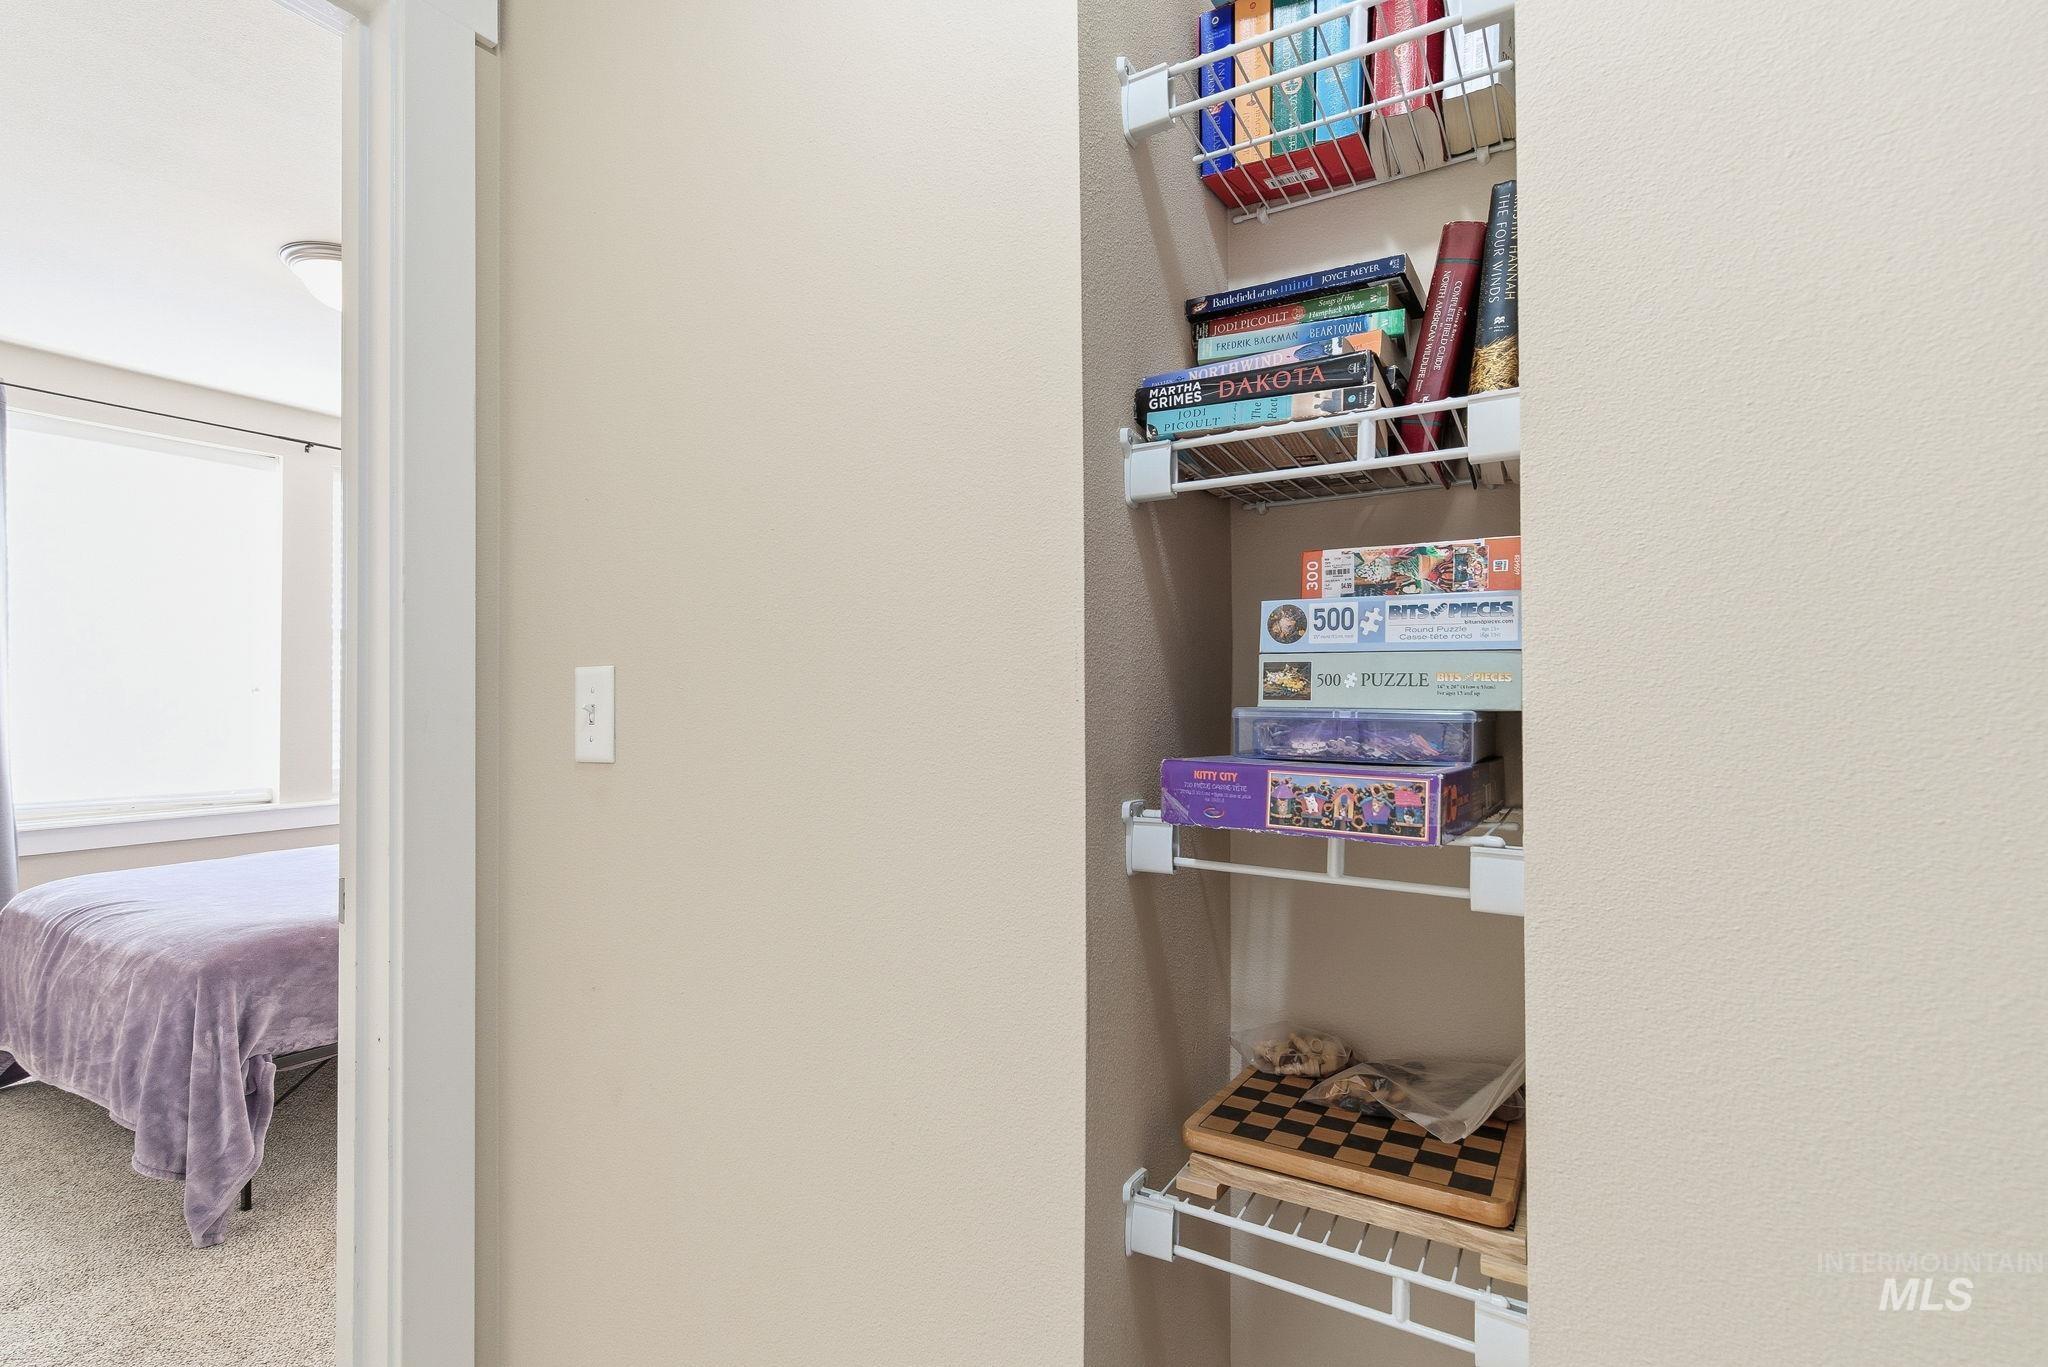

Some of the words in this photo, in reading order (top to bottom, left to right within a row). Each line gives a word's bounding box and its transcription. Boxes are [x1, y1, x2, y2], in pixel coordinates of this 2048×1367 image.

[1497, 193, 1510, 217] THE
[1493, 221, 1508, 257] FOUR
[1321, 270, 1348, 285] JOYCE
[1350, 264, 1380, 277] MEYER
[1437, 270, 1451, 299] NORTH
[1488, 260, 1504, 304] WINDS
[1212, 289, 1256, 308] Battlefield
[1257, 289, 1265, 298] of
[1266, 287, 1279, 296] the
[1280, 277, 1313, 293] mind
[1445, 280, 1463, 323] COMPLETE
[1213, 323, 1239, 336] JODI
[1241, 311, 1289, 329] PICOULT
[1309, 320, 1363, 338] BEARTOWN
[1427, 300, 1442, 343] AMERICAN
[1216, 336, 1251, 351] FREDRIK
[1254, 331, 1298, 345] BACKMAN
[1440, 323, 1453, 345] FIELD
[1188, 352, 1283, 380] NORTHWIND
[1417, 343, 1432, 379] WILDLIFE
[1433, 346, 1446, 371] GUIDE
[1149, 381, 1202, 399] MARTHA
[1218, 365, 1326, 398] DAKOTA
[1148, 391, 1202, 410] GRIMES
[1251, 402, 1262, 420] The
[1164, 417, 1221, 431] PICOULT
[1178, 408, 1207, 420] JODI
[1306, 561, 1319, 591] 300
[1313, 607, 1354, 631] 500
[1388, 603, 1430, 620] BITS
[1448, 600, 1514, 618] PIECES
[1436, 625, 1467, 633] Puzzle
[1451, 632, 1473, 640] rond
[1316, 673, 1341, 688] 500
[1360, 673, 1430, 687] PUZZLE
[1436, 672, 1462, 682] BITS
[1473, 671, 1513, 682] PIECES
[1193, 770, 1218, 781] KITTY
[1219, 771, 1238, 782] CITY
